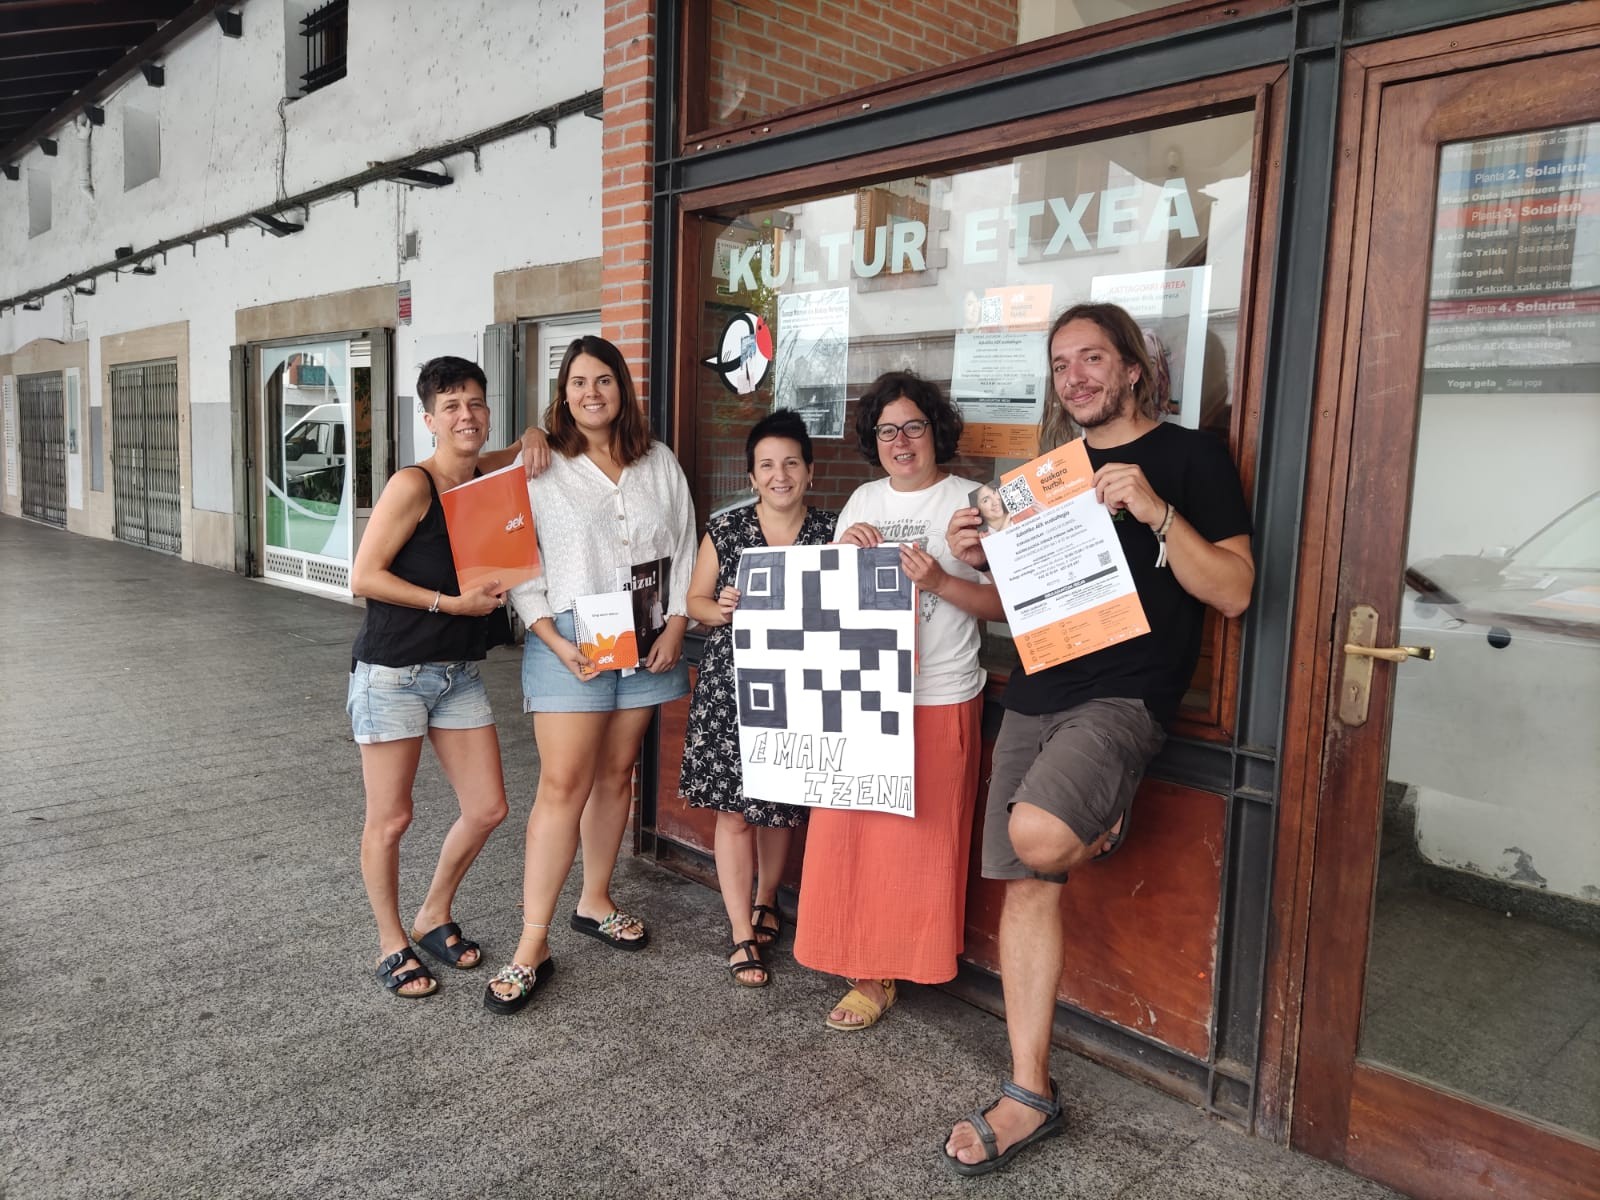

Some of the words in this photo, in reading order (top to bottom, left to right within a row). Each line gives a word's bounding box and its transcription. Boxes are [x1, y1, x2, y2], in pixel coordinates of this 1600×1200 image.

[1475, 171, 1505, 183] Planta
[1507, 169, 1520, 180] 2.
[1525, 161, 1587, 178] Solairua
[1472, 191, 1498, 201] Ondo
[1501, 184, 1555, 200] jubilatuen
[1472, 209, 1501, 221] Planta
[1503, 208, 1517, 219] 3.
[1521, 202, 1583, 217] Solairua
[729, 220, 927, 294] KULTUR
[962, 177, 1200, 266] ETXEA
[1466, 228, 1509, 240] Nagusia
[1522, 224, 1543, 235] Salón
[1446, 249, 1473, 259] Areto
[1475, 247, 1508, 257] Txikia
[1475, 266, 1504, 278] gelak
[1160, 279, 1187, 290] ARTEA
[1466, 304, 1497, 315] Planta
[1498, 303, 1512, 313] 4.
[1516, 299, 1576, 312] Solairua
[1447, 379, 1472, 389] Yoga
[1474, 379, 1497, 389] gela
[1036, 458, 1054, 477] aek
[1040, 468, 1068, 484] euskara
[1043, 478, 1065, 492] hurbil,
[505, 512, 525, 531] aek
[902, 524, 927, 538] COME
[622, 570, 657, 592] aizu!
[598, 653, 615, 665] aek
[749, 731, 847, 771] EMAN
[803, 772, 913, 810] IZENA
